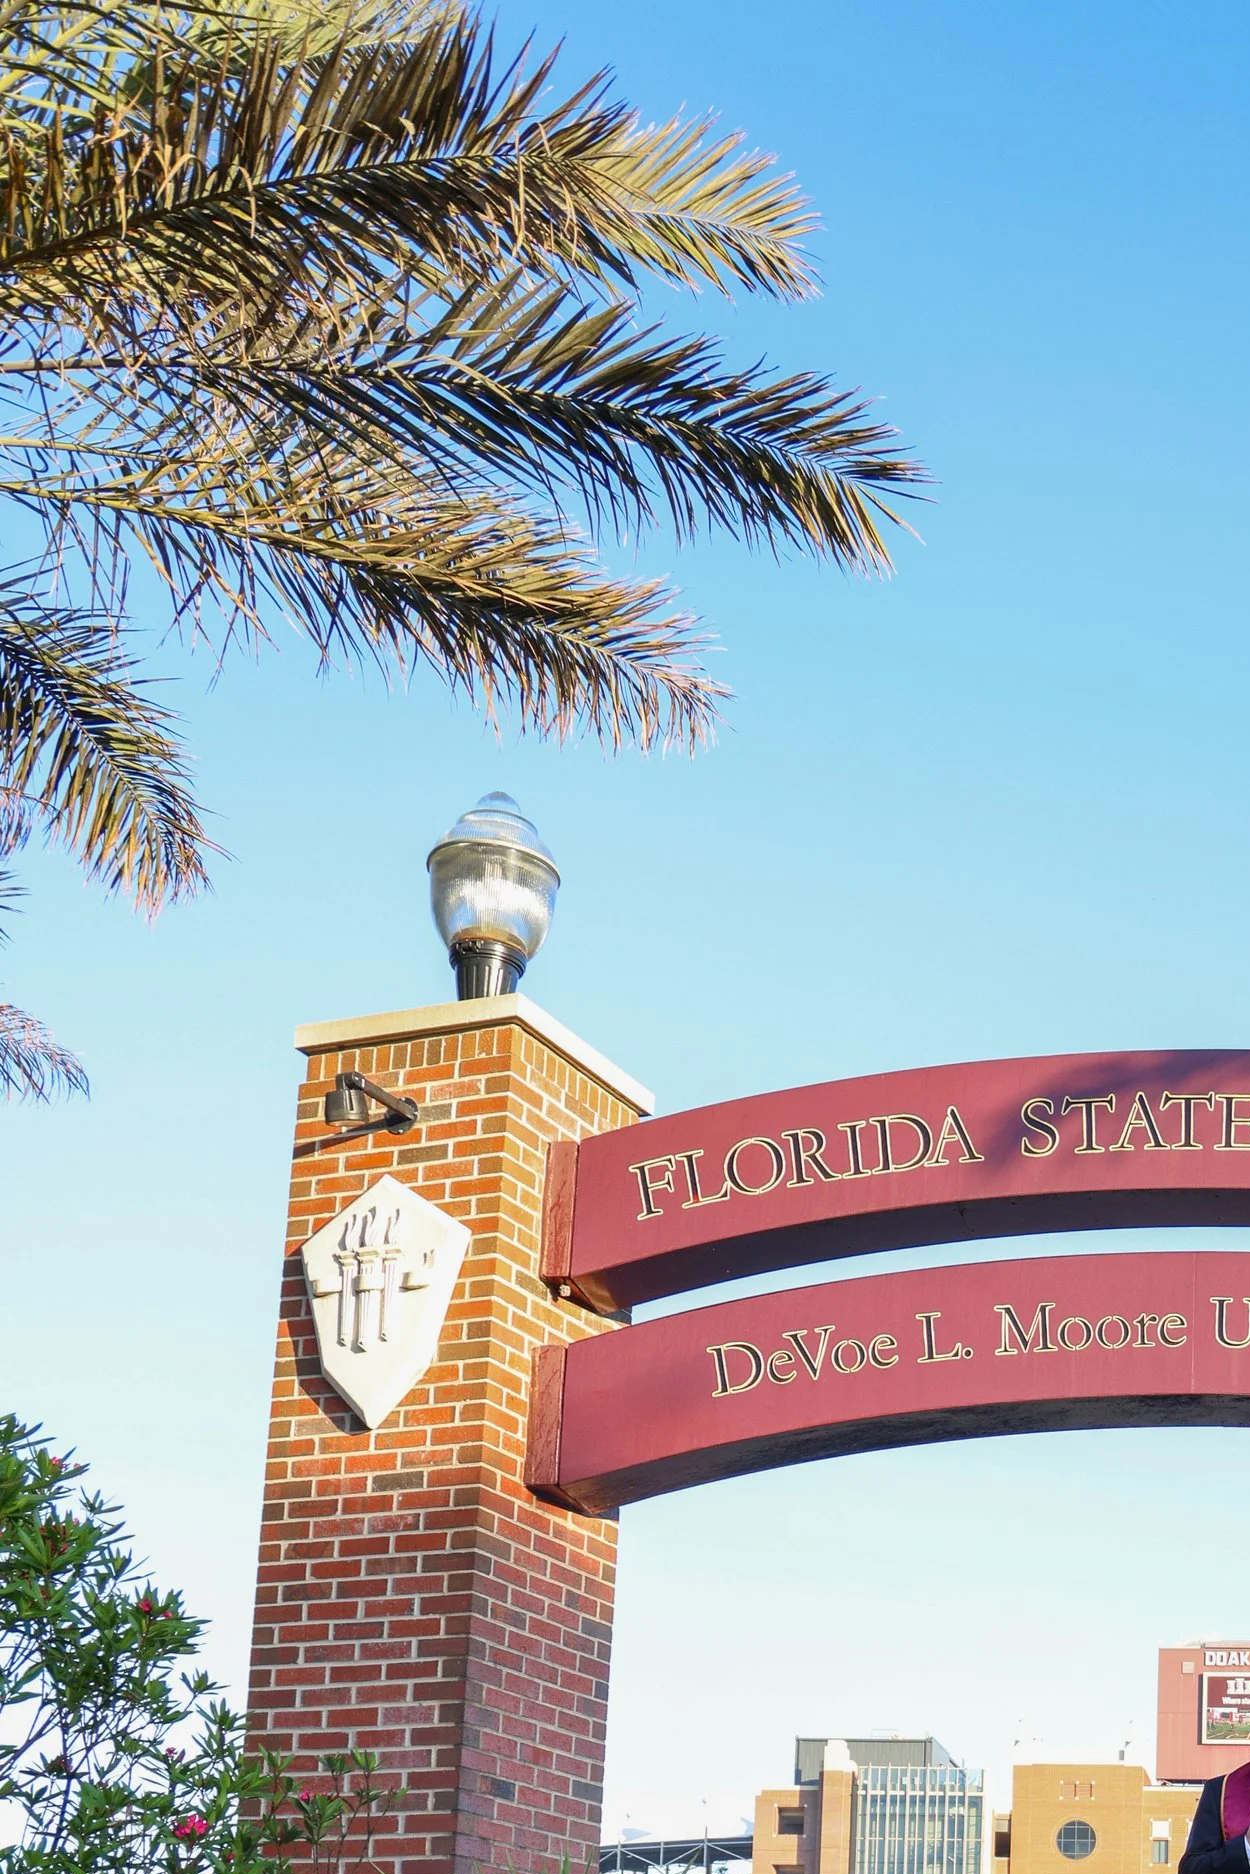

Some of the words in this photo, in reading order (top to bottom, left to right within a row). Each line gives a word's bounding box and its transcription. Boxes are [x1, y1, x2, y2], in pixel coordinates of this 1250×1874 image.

[628, 1105, 985, 1221] FLORIDA
[706, 1325, 899, 1398] DeVoe
[914, 1312, 974, 1364] L.
[994, 1302, 1189, 1356] Moore
[1204, 1651, 1250, 1666] DOAK
